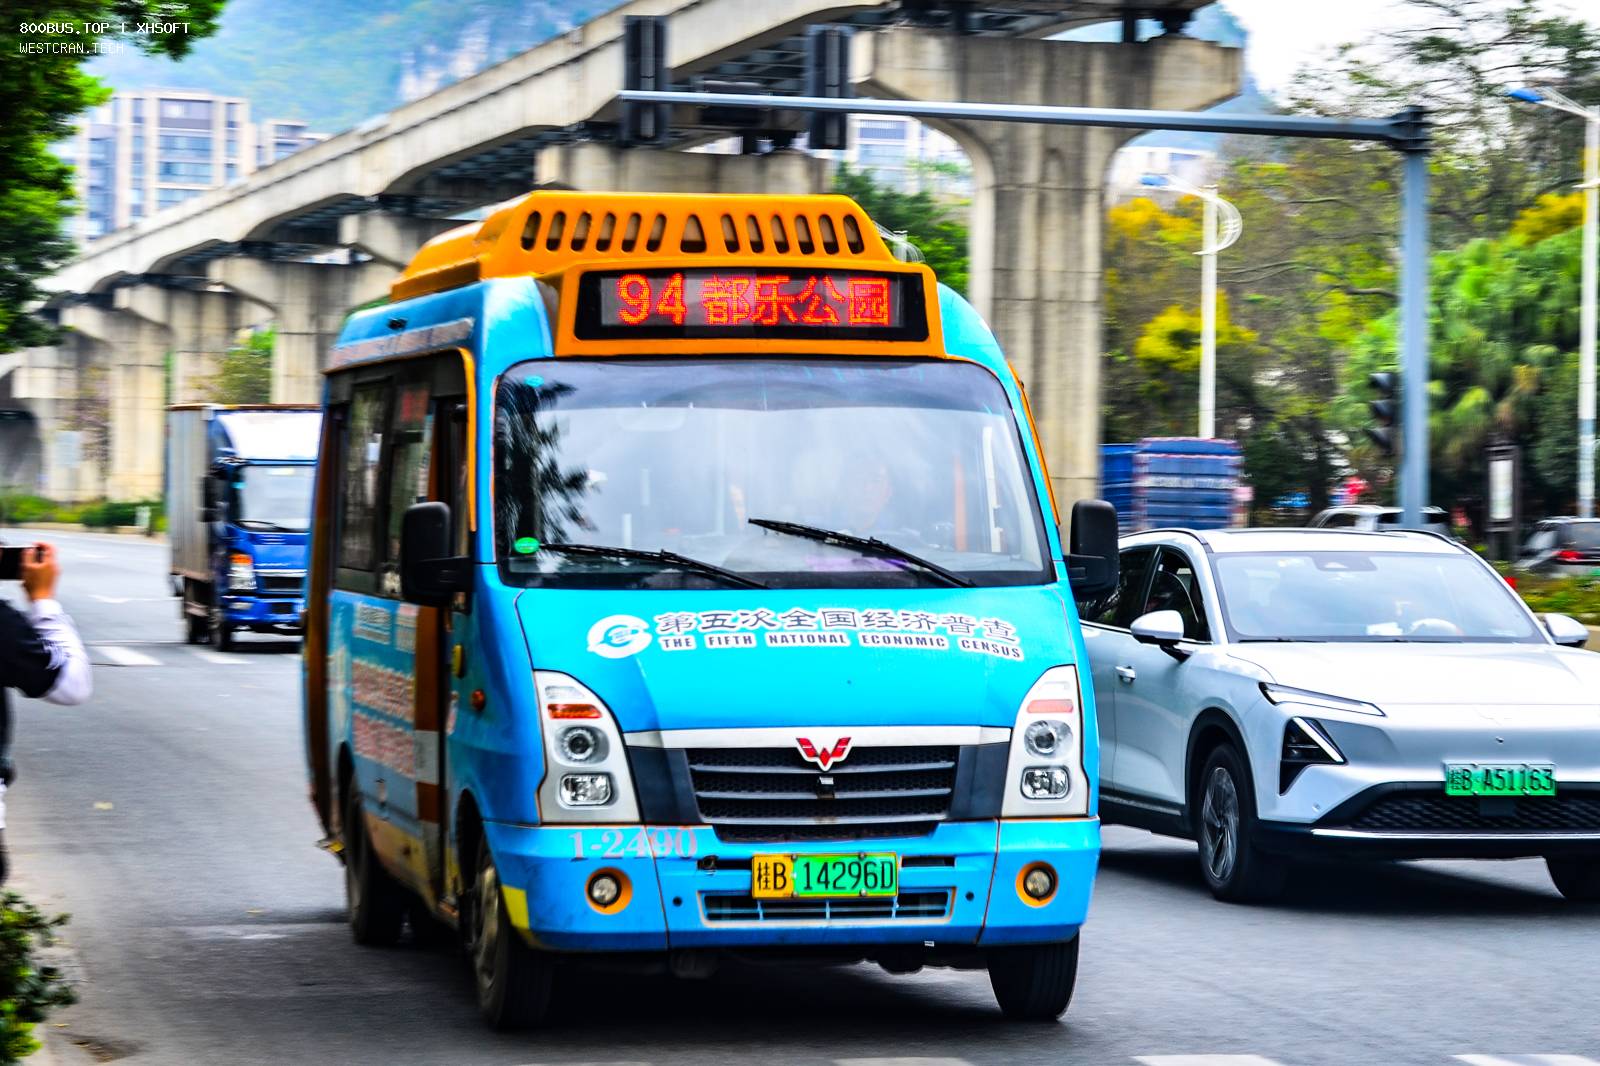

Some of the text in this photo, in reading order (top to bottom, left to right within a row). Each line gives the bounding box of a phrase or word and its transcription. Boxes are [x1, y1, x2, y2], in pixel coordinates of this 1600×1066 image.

[617, 273, 890, 326] 94 都乐公园
[656, 609, 1017, 643] 第五次全国经济普查
[662, 632, 1021, 659] THE FIFTH NATIONAL ECONOMIC CENSUS
[568, 827, 697, 859] 1-2490
[756, 858, 895, 891] 桂B 14296D
